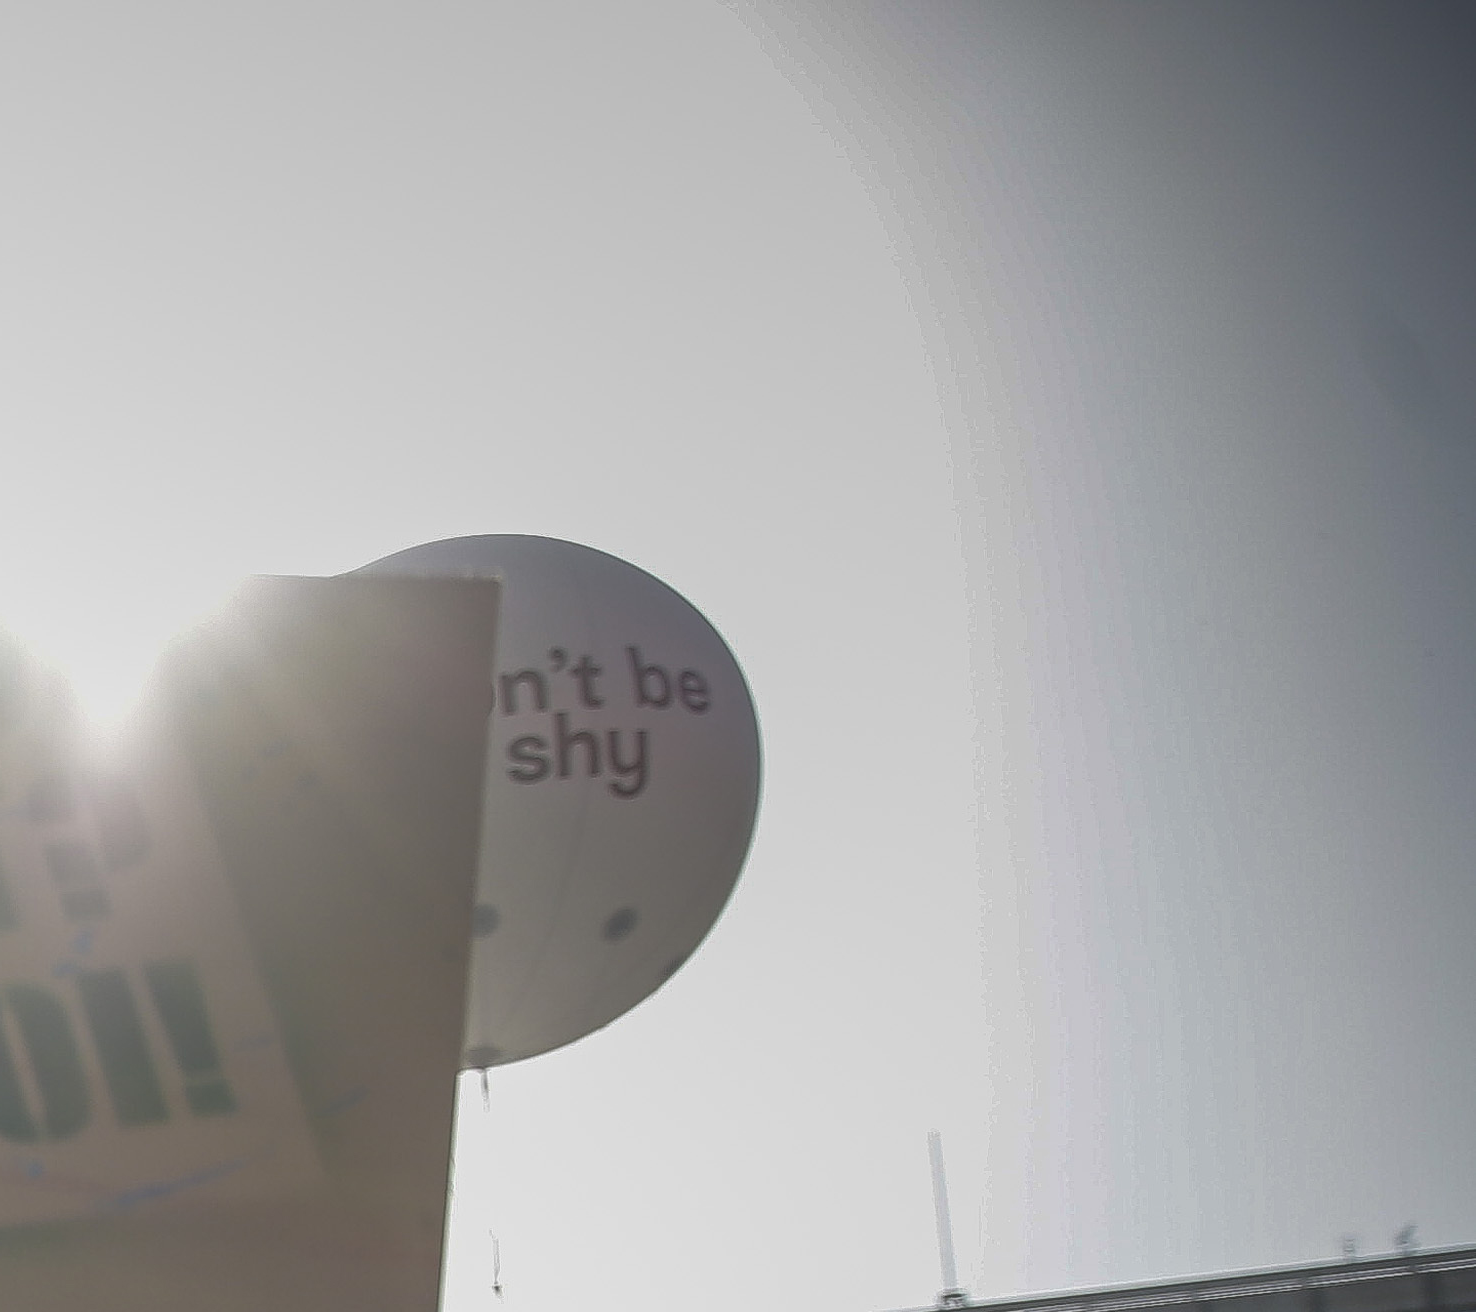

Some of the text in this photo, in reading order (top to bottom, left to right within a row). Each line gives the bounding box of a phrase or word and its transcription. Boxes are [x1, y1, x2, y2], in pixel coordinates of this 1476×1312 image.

[498, 645, 710, 716] n't be
[506, 711, 646, 798] shy
